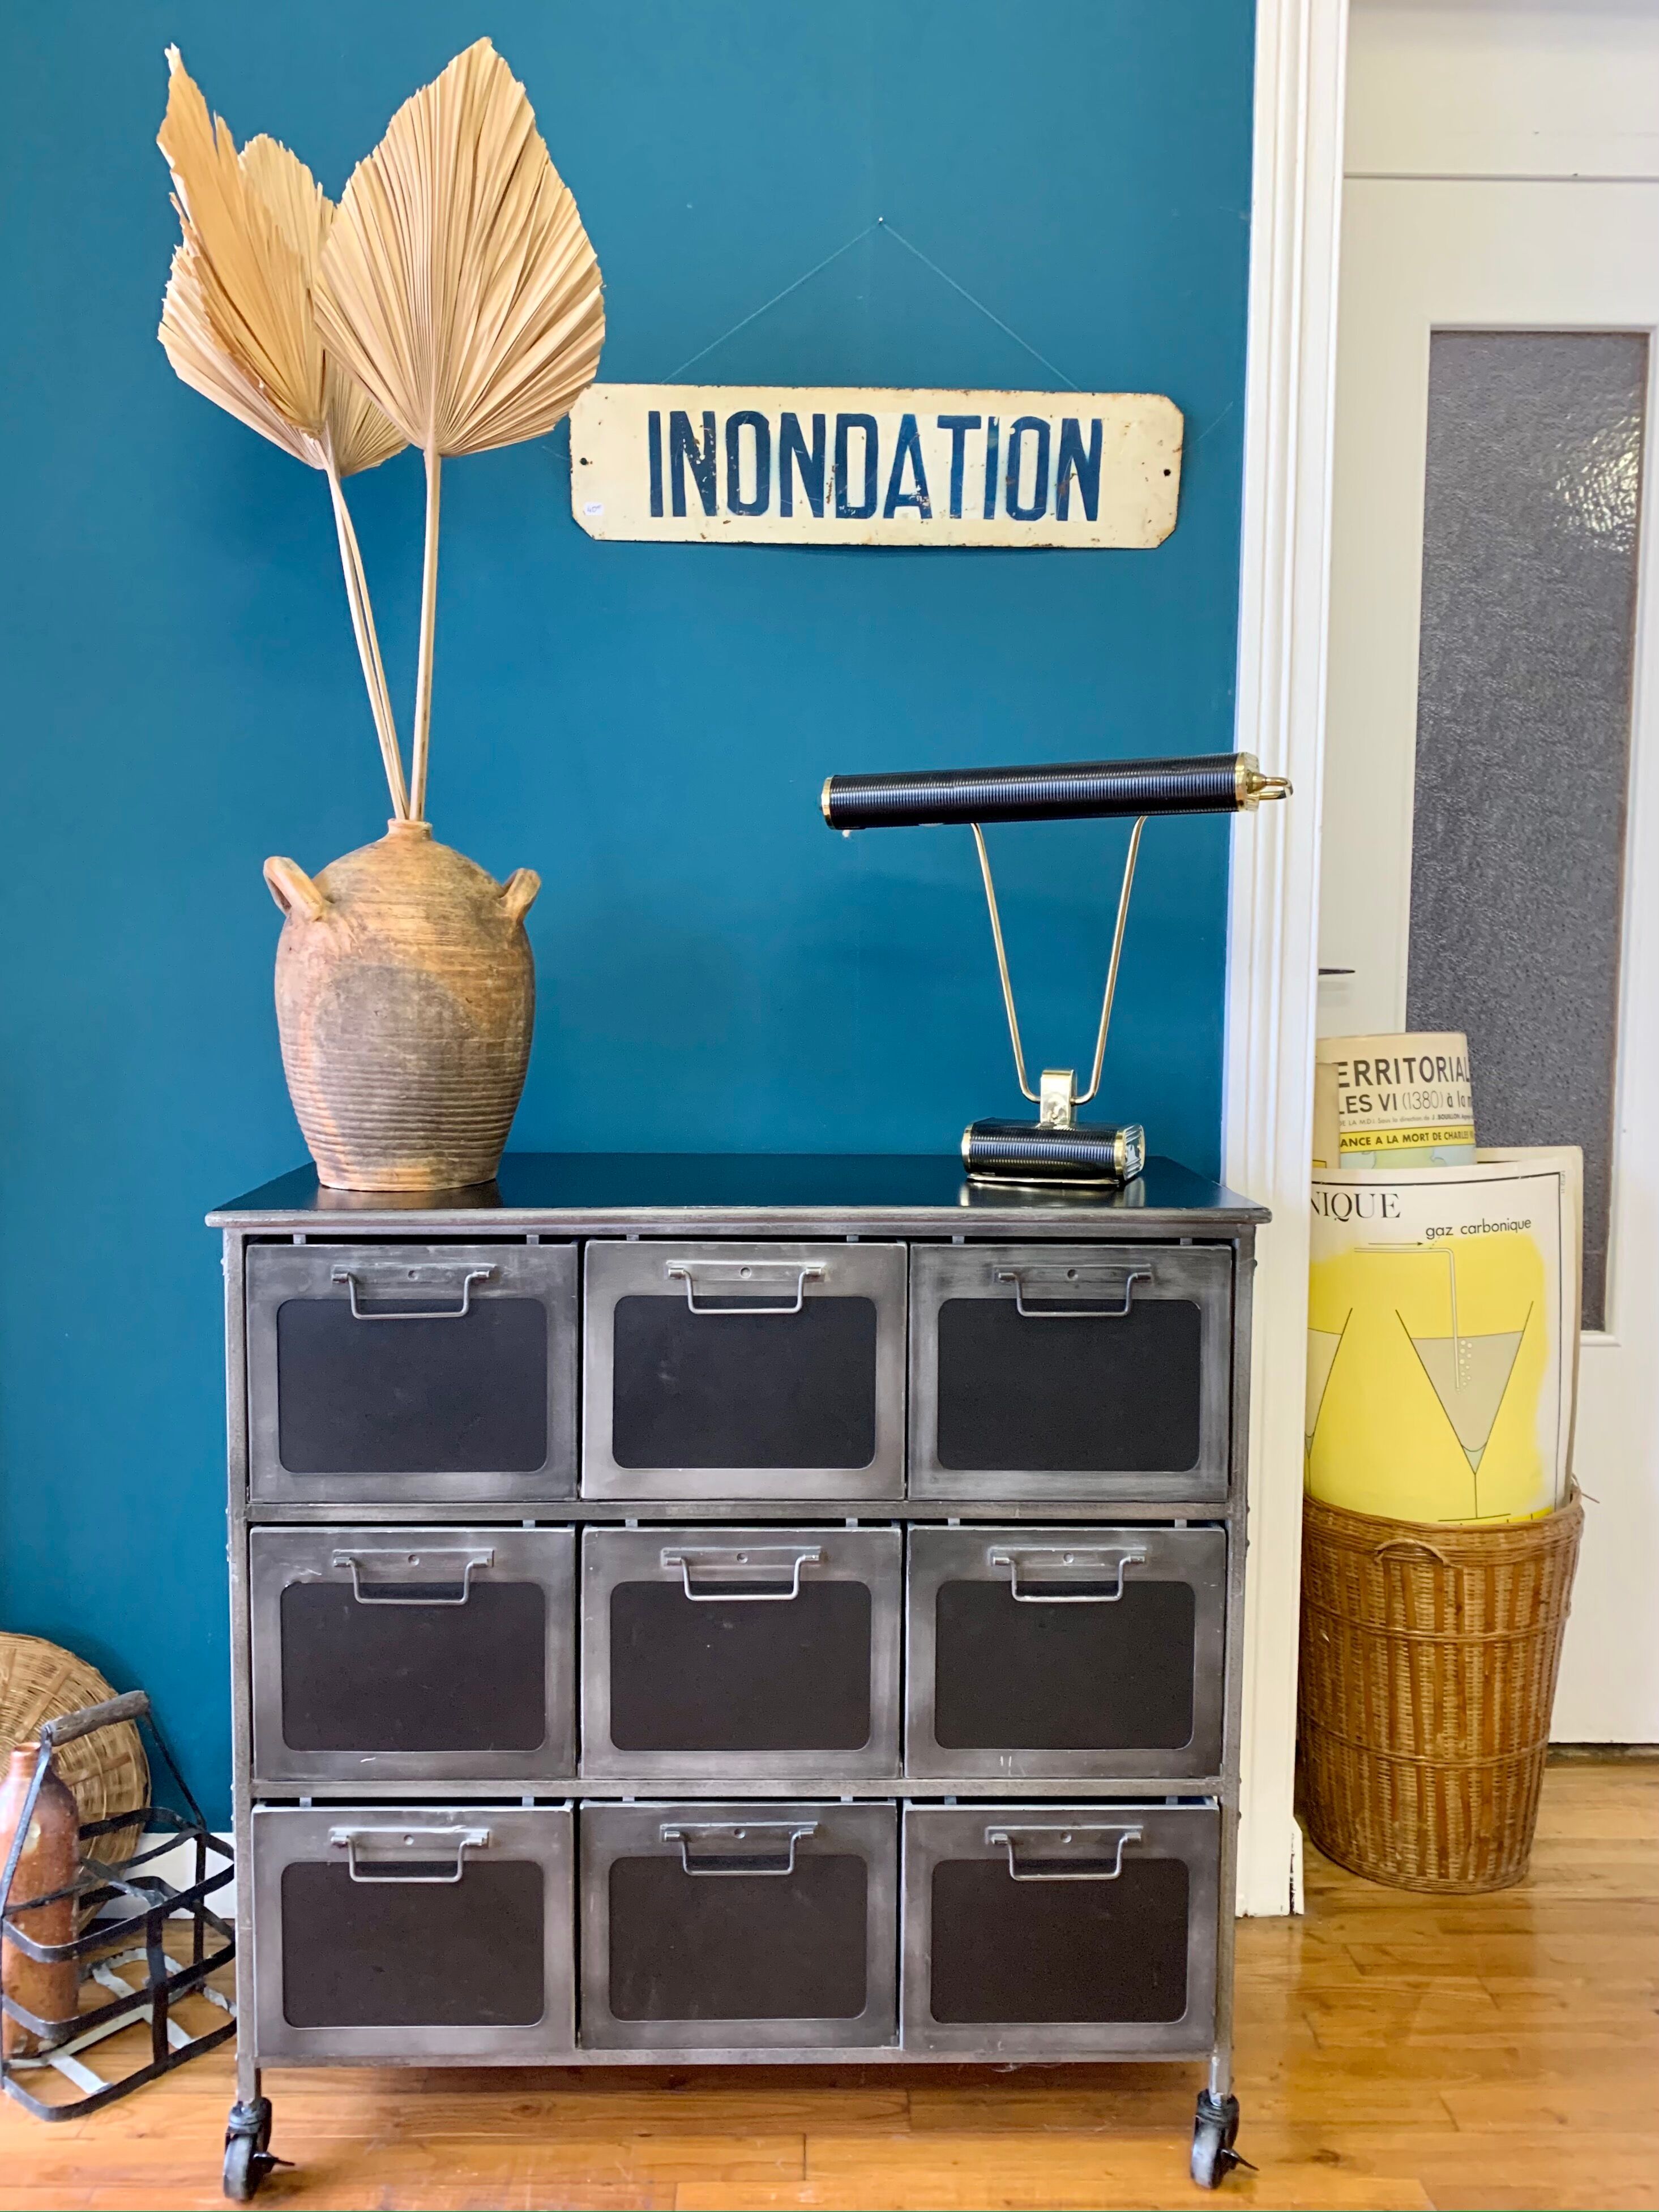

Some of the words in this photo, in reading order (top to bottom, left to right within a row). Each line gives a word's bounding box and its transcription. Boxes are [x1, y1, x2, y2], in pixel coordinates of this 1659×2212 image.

[648, 410, 1102, 521] INONDATION
[1378, 1093, 1397, 1111] VI
[1402, 1090, 1443, 1110] (1380)
[1447, 1093, 1453, 1107] à
[1457, 1090, 1466, 1107] la
[1340, 1137, 1371, 1147] ANCE
[1375, 1136, 1383, 1145] A
[1387, 1135, 1399, 1144] LA
[1403, 1132, 1429, 1143] MORT
[1433, 1132, 1442, 1141] DE
[1444, 1131, 1469, 1140] CHARLES
[1426, 1226, 1453, 1240] gaz
[1460, 1218, 1531, 1234] carbonique
